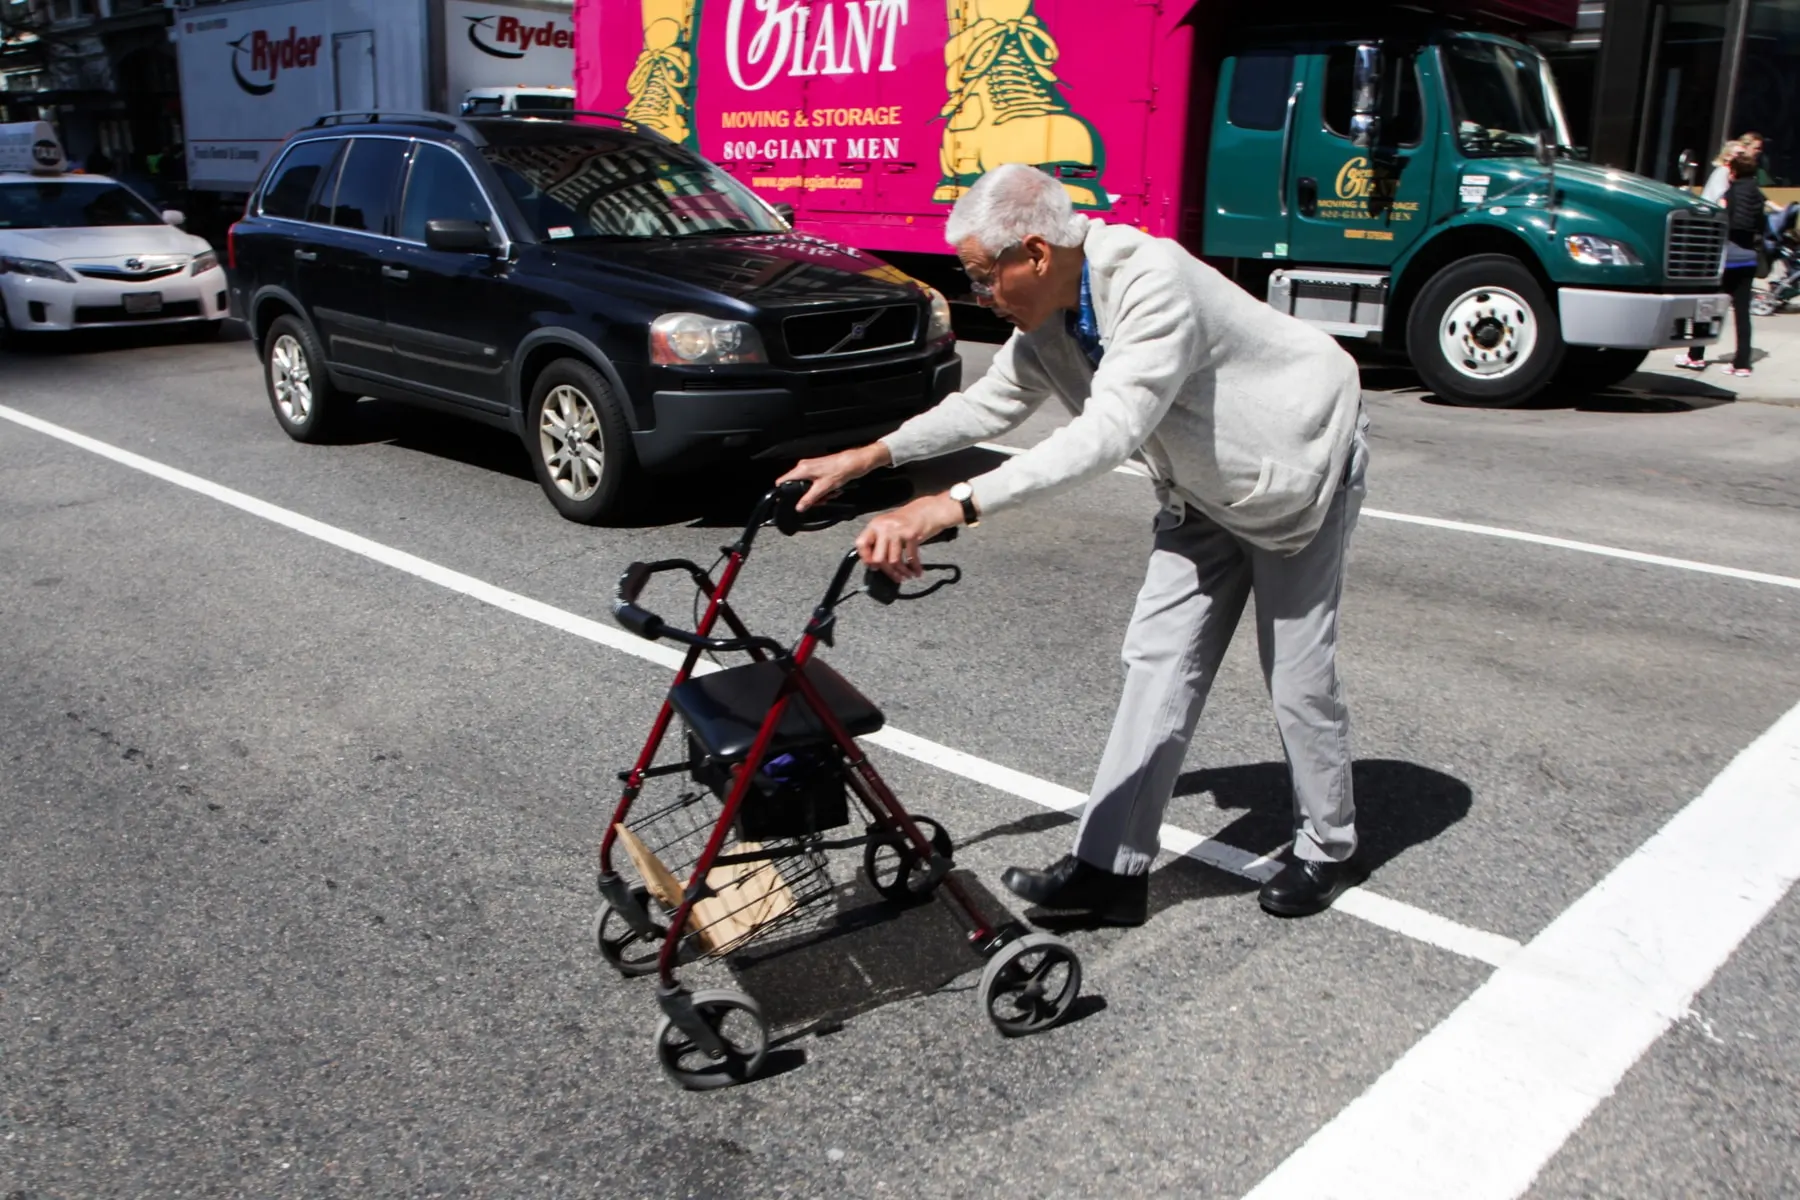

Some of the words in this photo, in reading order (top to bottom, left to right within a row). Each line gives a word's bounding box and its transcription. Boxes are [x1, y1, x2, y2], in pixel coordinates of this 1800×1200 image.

[251, 25, 322, 80] Ryder
[721, 110, 790, 129] MOVING
[793, 110, 809, 127] &
[812, 106, 902, 127] STORAGE
[723, 138, 837, 160] 800-GIANT
[846, 138, 900, 159] MEN
